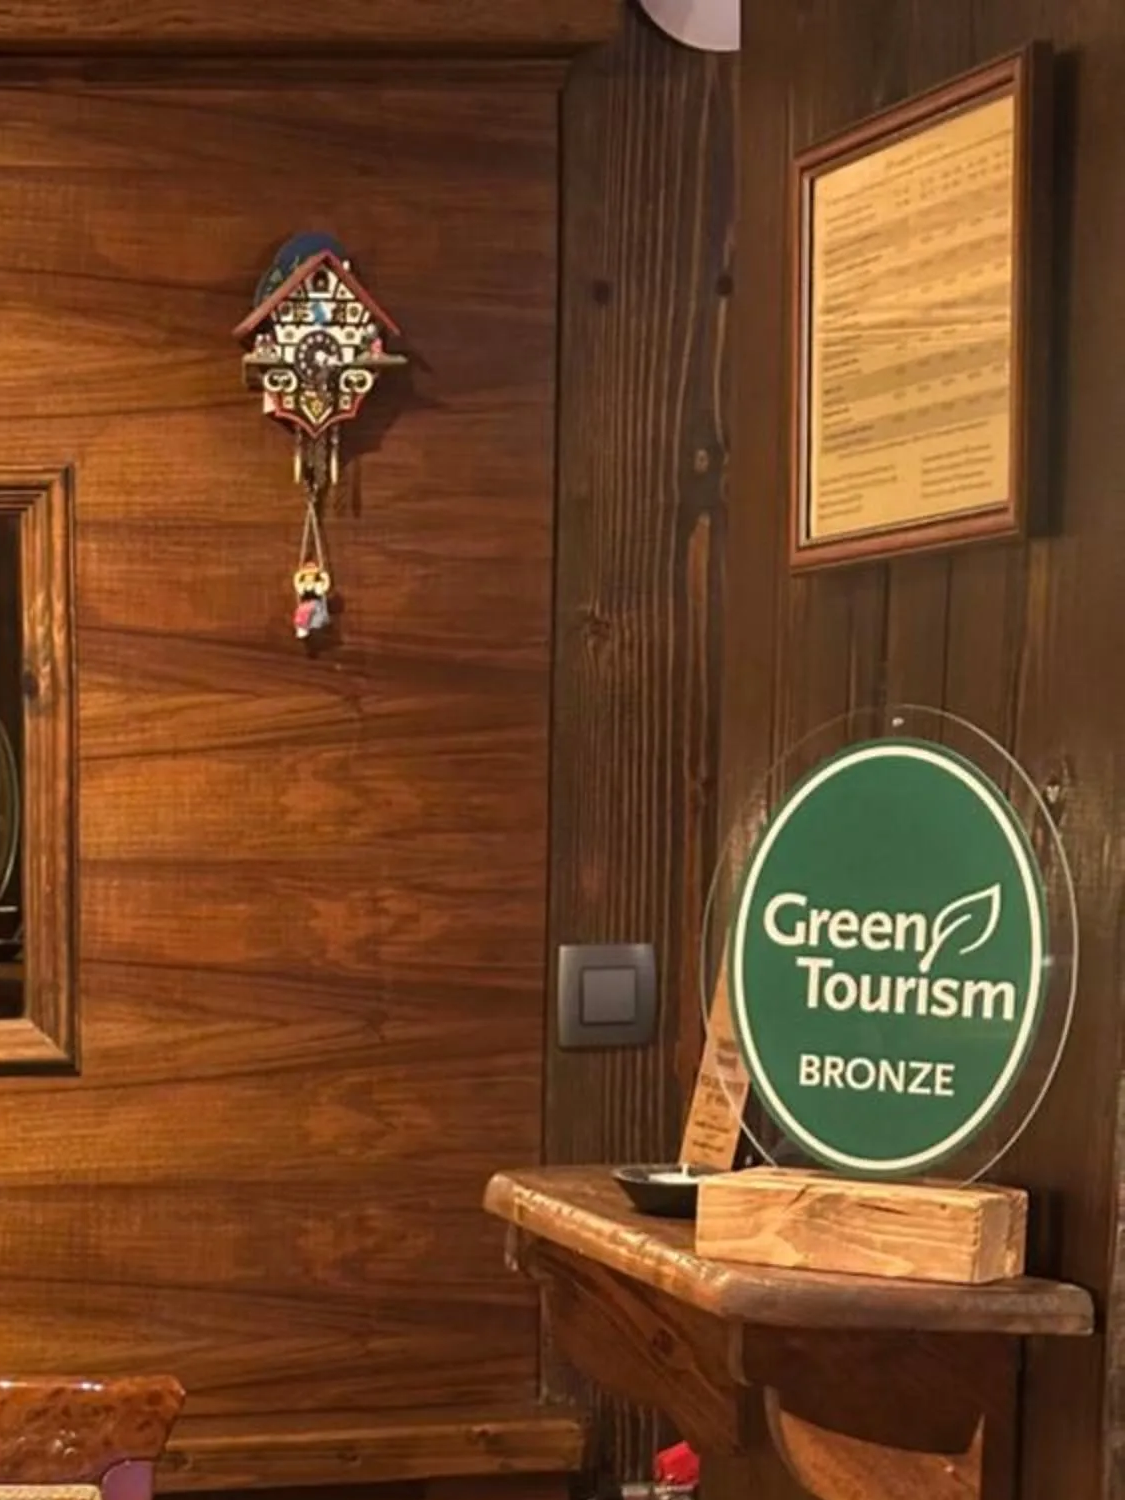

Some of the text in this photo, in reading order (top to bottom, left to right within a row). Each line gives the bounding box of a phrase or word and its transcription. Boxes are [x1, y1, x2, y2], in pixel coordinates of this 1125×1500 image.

[763, 892, 926, 952] Green
[796, 956, 1016, 1021] Tourism
[799, 1054, 955, 1096] BRONZE
